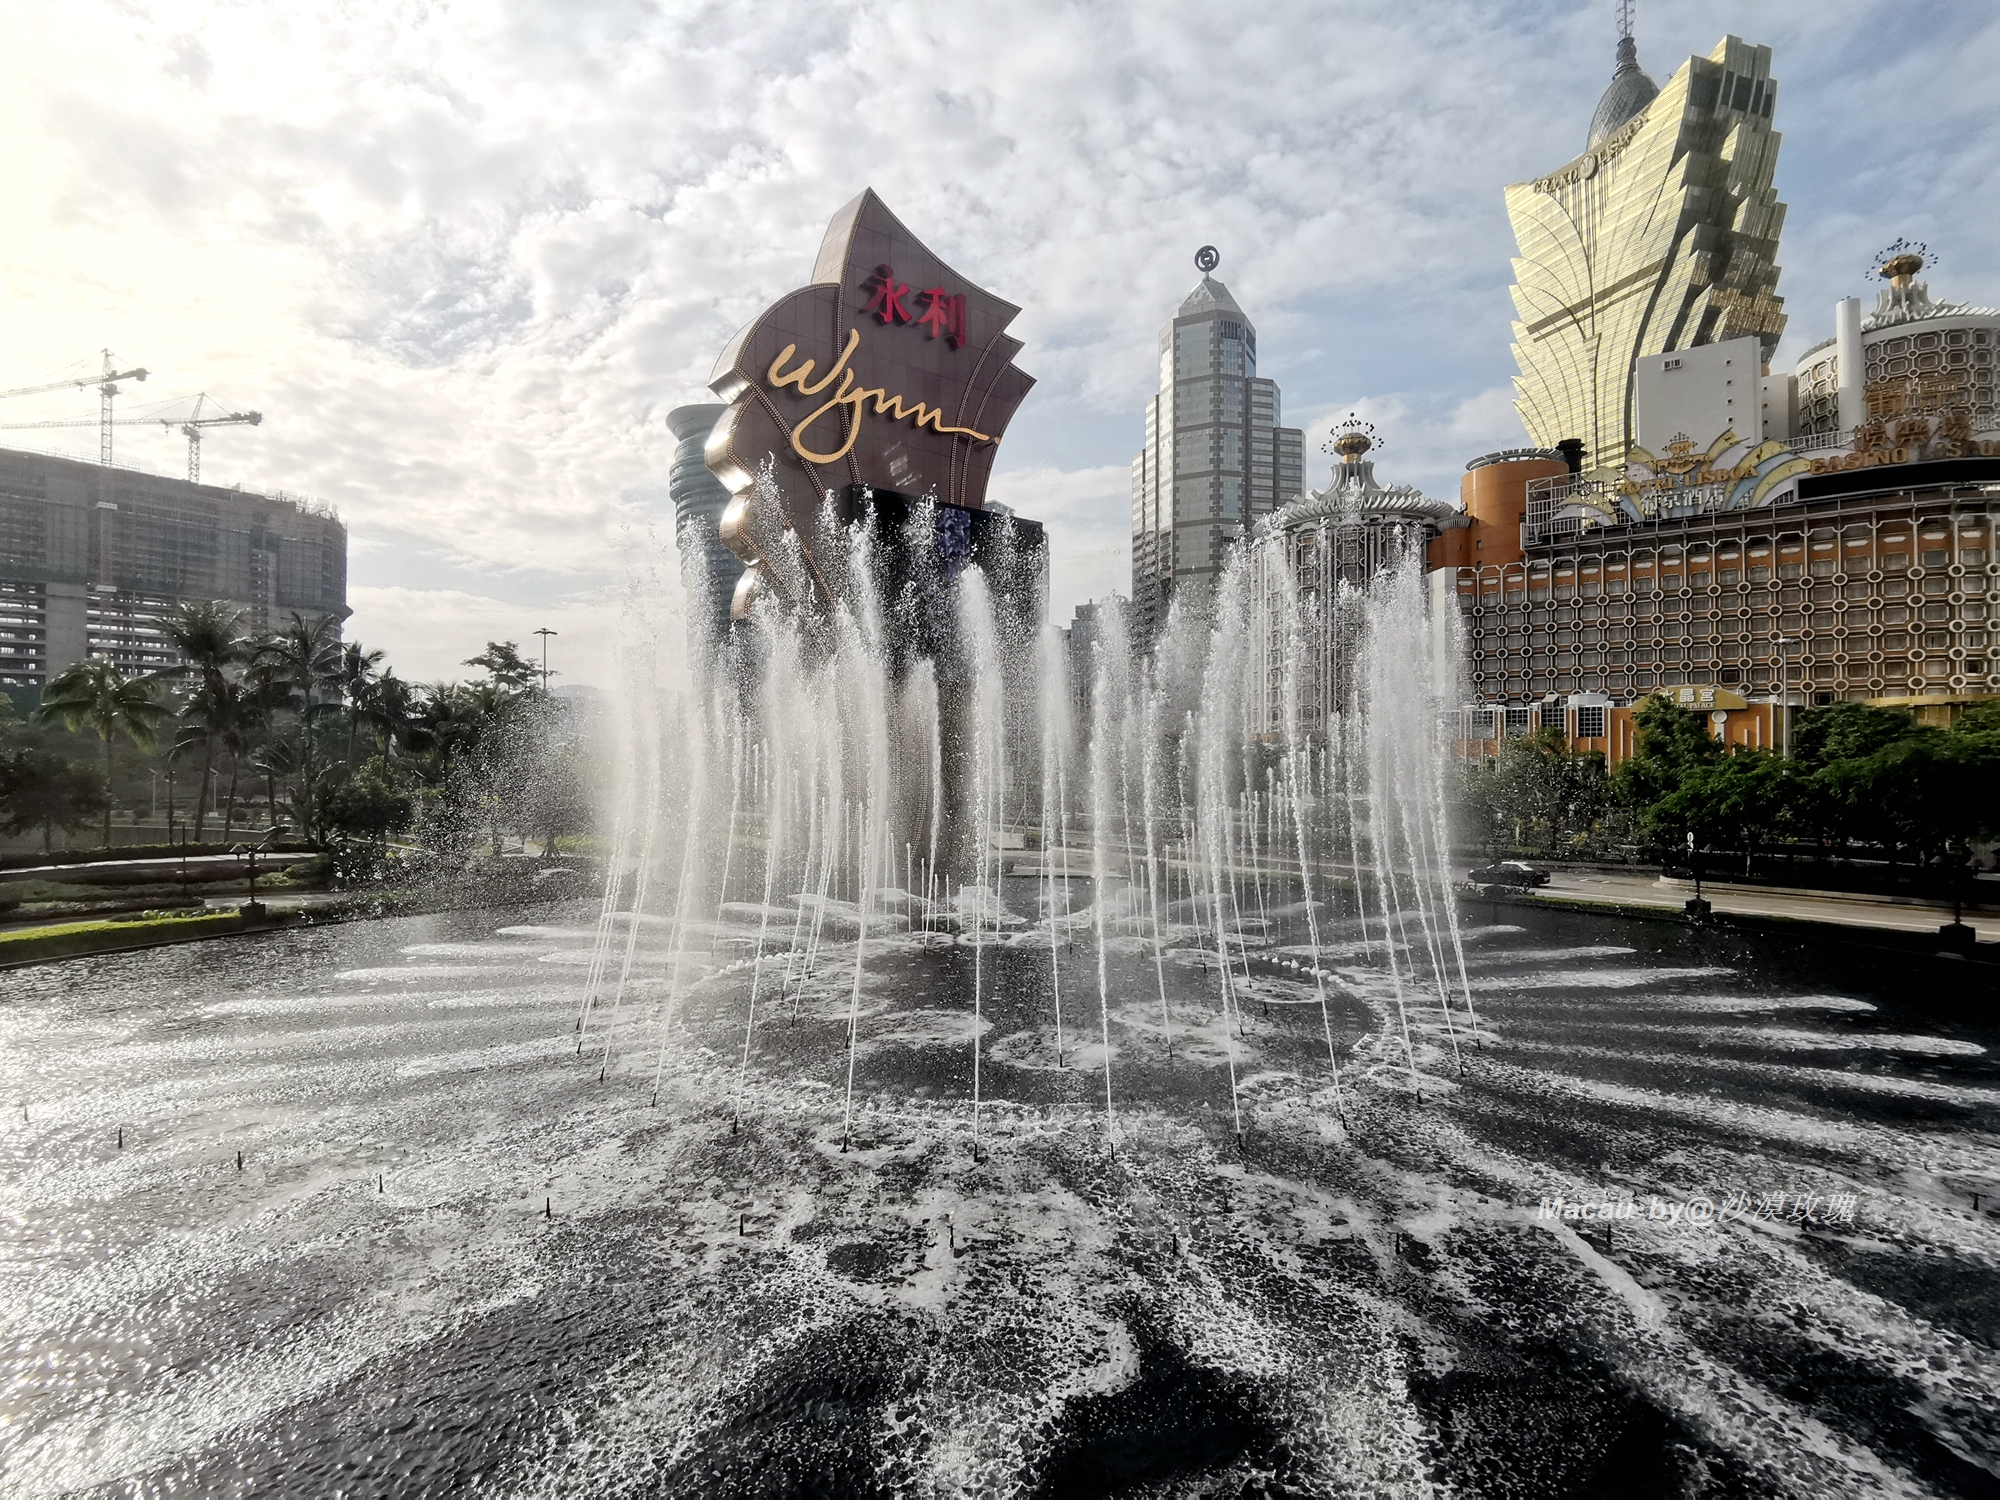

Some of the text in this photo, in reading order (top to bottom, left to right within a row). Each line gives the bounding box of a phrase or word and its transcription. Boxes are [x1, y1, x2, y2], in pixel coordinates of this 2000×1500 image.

[1534, 167, 1579, 194] GRAND
[865, 264, 966, 349] 永利
[767, 328, 1000, 464] Wynn
[1810, 448, 1908, 475] CASINO
[1614, 465, 1758, 495] HOTEL LISBOA
